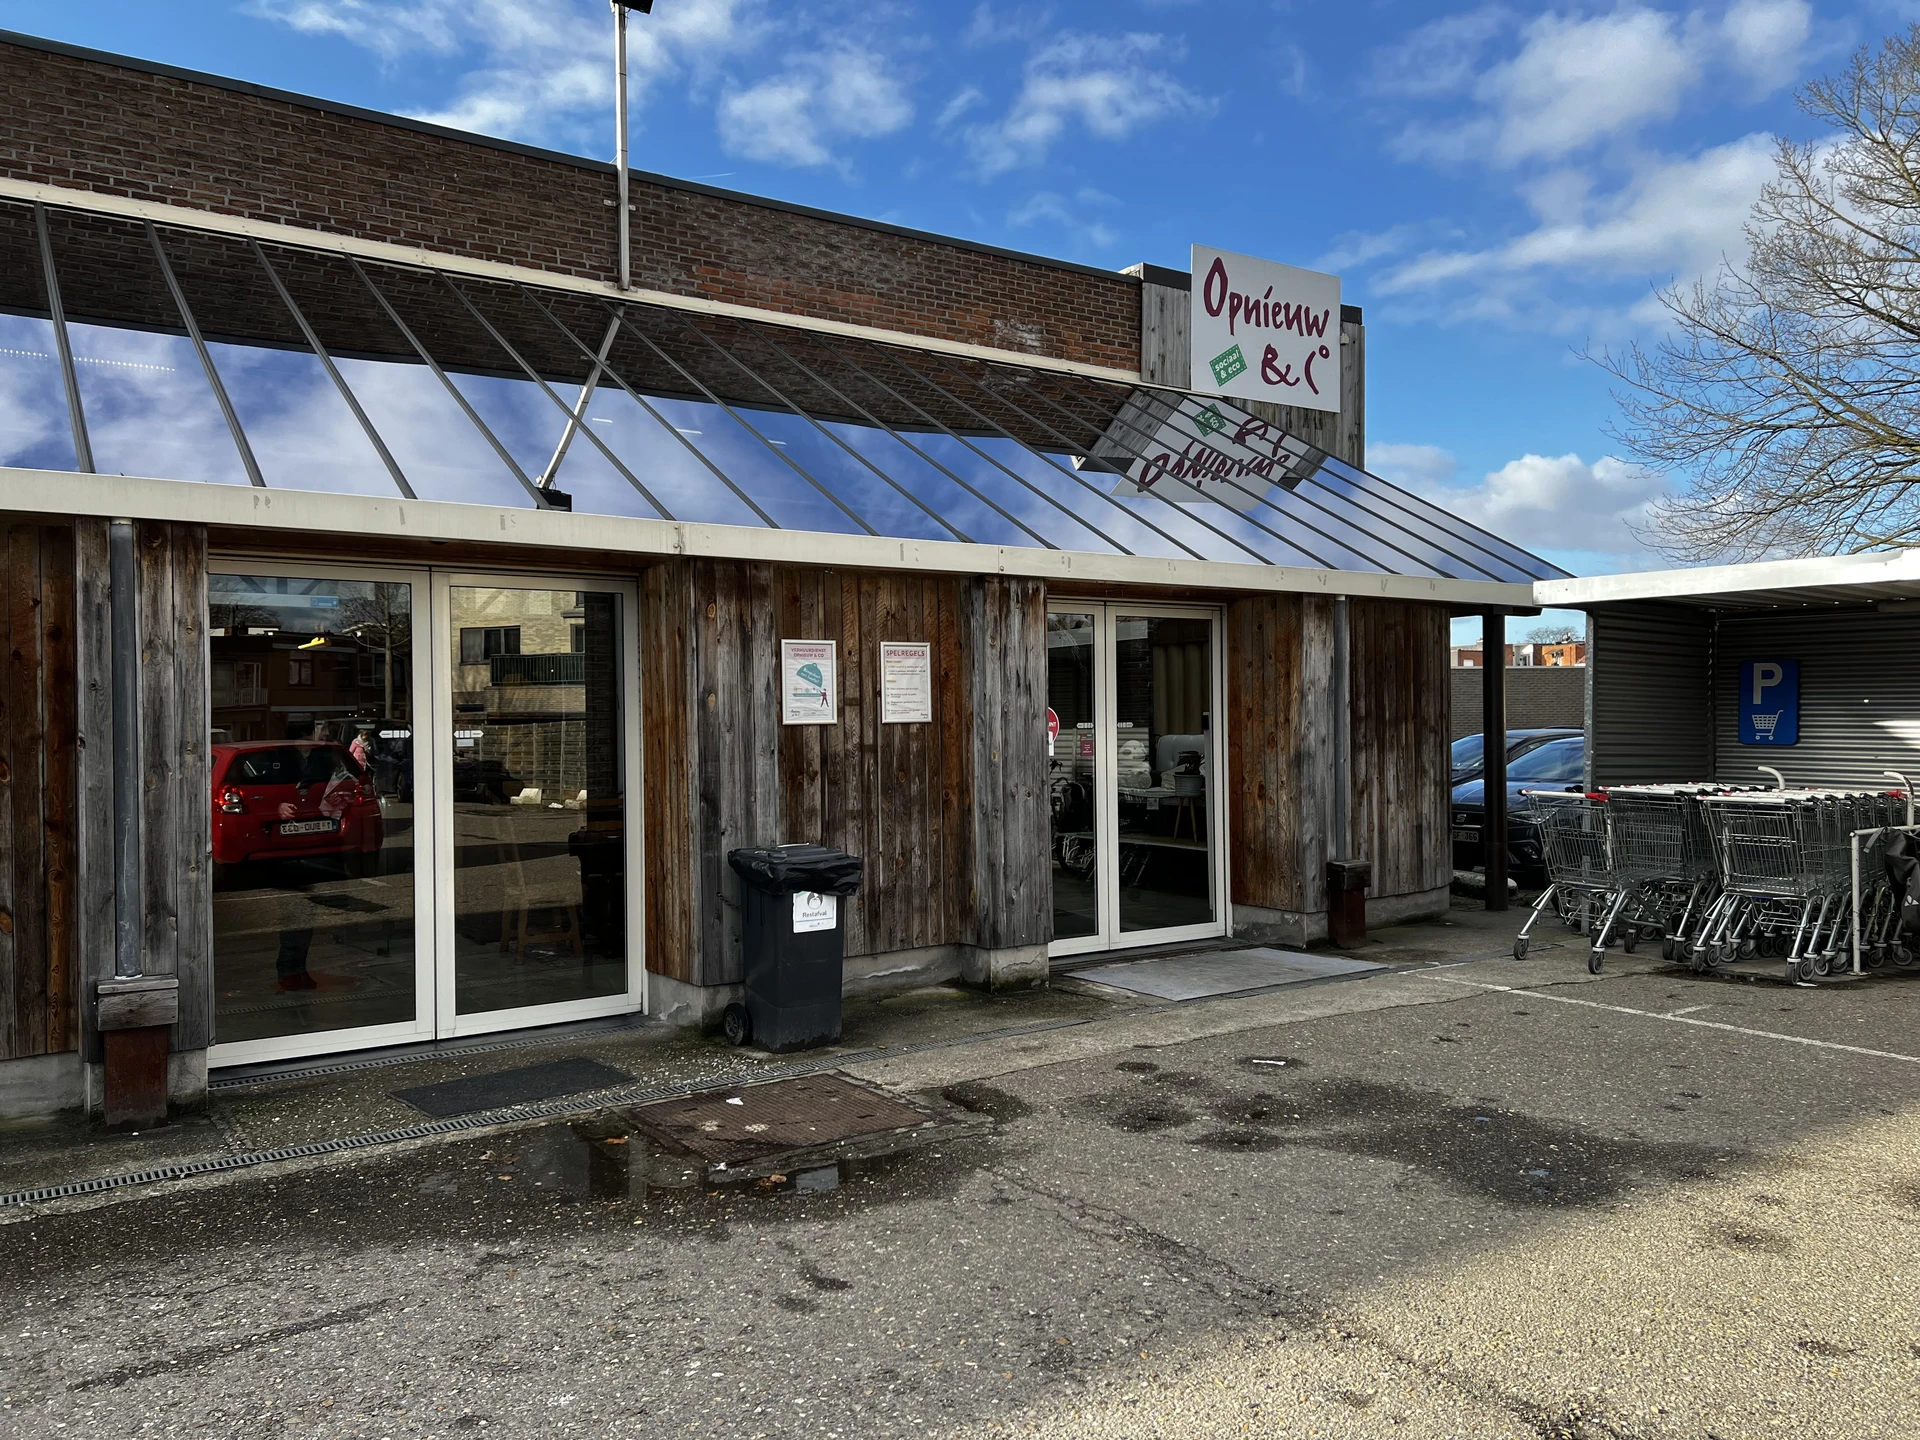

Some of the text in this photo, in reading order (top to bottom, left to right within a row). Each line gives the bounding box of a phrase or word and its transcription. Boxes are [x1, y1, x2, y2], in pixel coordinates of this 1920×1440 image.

[1203, 257, 1330, 338] Opnieuw
[1215, 350, 1239, 372] sociaal
[1220, 362, 1240, 379] & eco
[1261, 344, 1300, 387] &
[1753, 663, 1783, 704] P
